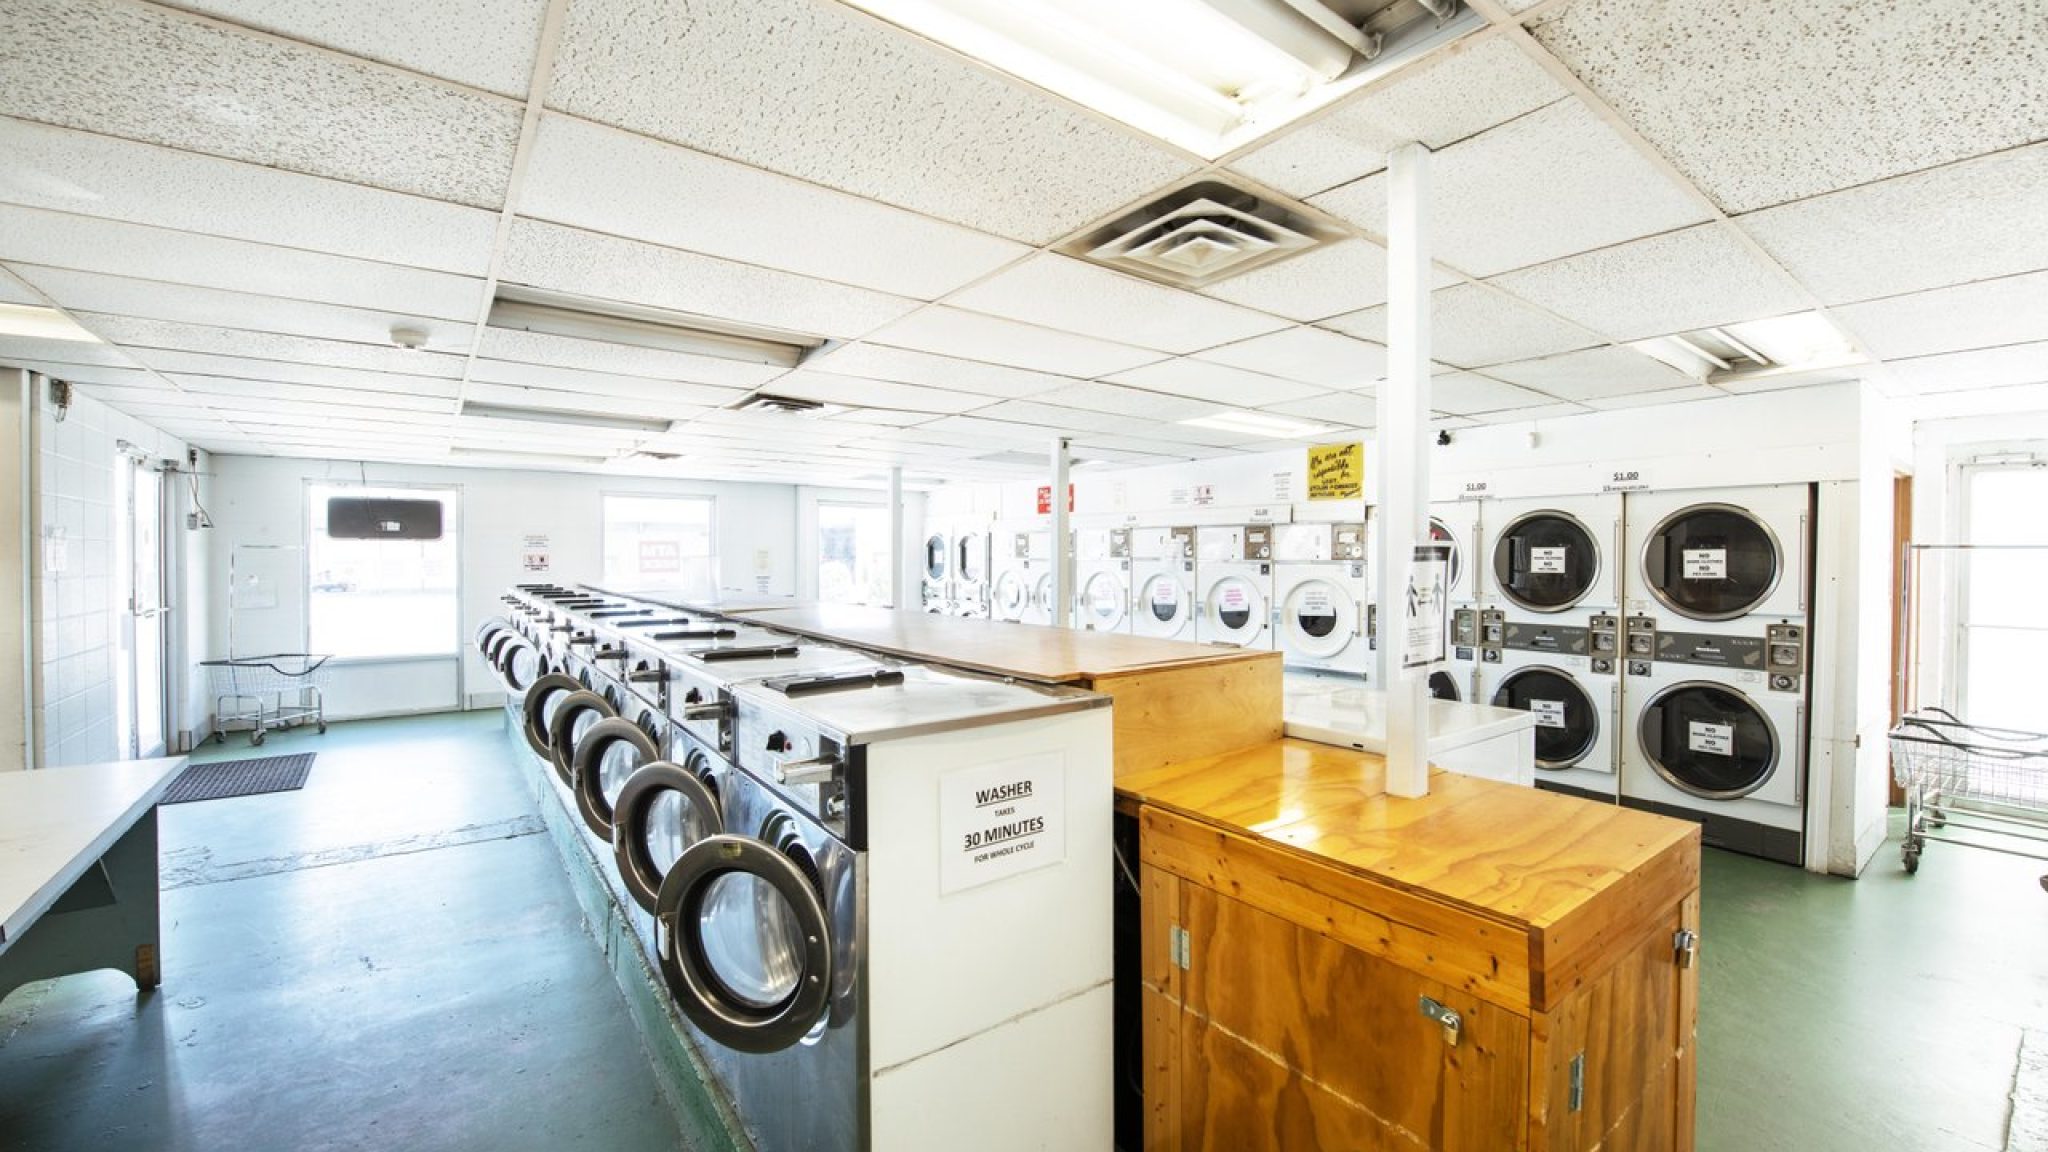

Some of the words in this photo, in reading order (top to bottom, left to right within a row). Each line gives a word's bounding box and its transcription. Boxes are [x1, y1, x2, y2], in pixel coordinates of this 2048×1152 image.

[1614, 472, 1639, 481] $1.00
[1466, 483, 1487, 492] $1.00
[975, 780, 1033, 804] WASHER
[994, 806, 1016, 817] TAKES
[964, 831, 981, 849] 30
[984, 815, 1045, 843] MINUTES
[974, 854, 989, 863] FOR
[990, 845, 1014, 860] WHOLE
[1015, 840, 1035, 853] CYCLE
